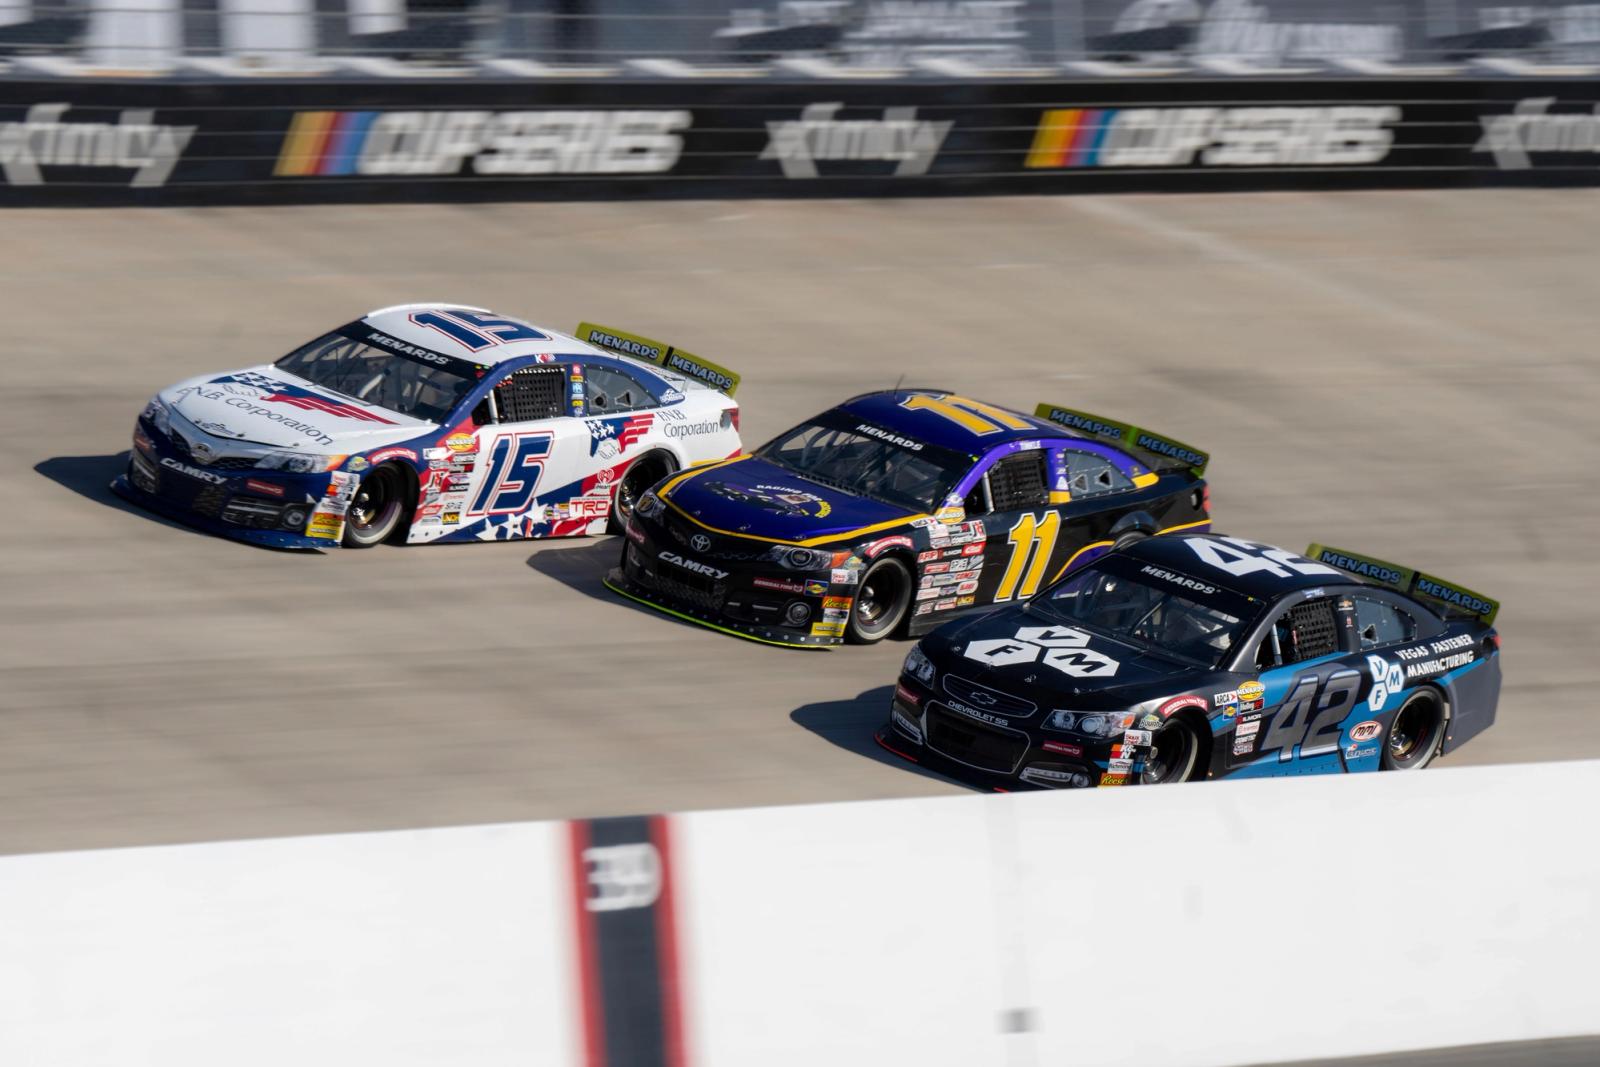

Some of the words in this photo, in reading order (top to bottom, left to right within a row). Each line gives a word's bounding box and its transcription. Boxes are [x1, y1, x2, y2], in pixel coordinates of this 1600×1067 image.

[356, 110, 494, 175] CUP
[473, 110, 692, 175] SERIES
[757, 101, 956, 178] xfinity
[1101, 107, 1224, 166] CUP
[1201, 105, 1402, 165] SERIES
[408, 309, 553, 353] 15
[589, 330, 660, 360] MENARDS
[367, 333, 450, 366] MENARDS
[671, 355, 733, 390] MENARDS
[225, 396, 334, 447] Corporation
[664, 420, 718, 440] Corporation
[897, 392, 1038, 437] 11
[1050, 409, 1122, 440] MENARDS
[855, 424, 924, 451] MENARDS
[1138, 435, 1205, 466] MENARDS
[160, 457, 228, 485] CAMRY
[466, 430, 554, 517] 15
[570, 500, 608, 515] TRD
[657, 551, 730, 580] CAMRY
[993, 509, 1061, 603] 11
[1184, 537, 1343, 578] 42
[1321, 551, 1401, 584] MENARDS
[1141, 565, 1215, 595] MENARDS
[1417, 579, 1493, 615] MENARDS
[1038, 629, 1079, 641] V
[1395, 645, 1430, 661] VEGAS
[1430, 633, 1475, 654] FASTENER
[984, 644, 1023, 657] F
[1053, 652, 1108, 674] M
[1374, 660, 1383, 678] V
[1389, 671, 1400, 687] M
[1407, 650, 1475, 678] MANUFACTURING
[1216, 693, 1230, 705] ARCA
[1375, 689, 1383, 705] F
[947, 700, 994, 723] CHEVROLET
[994, 717, 1009, 727] SS
[1261, 668, 1362, 762] 42
